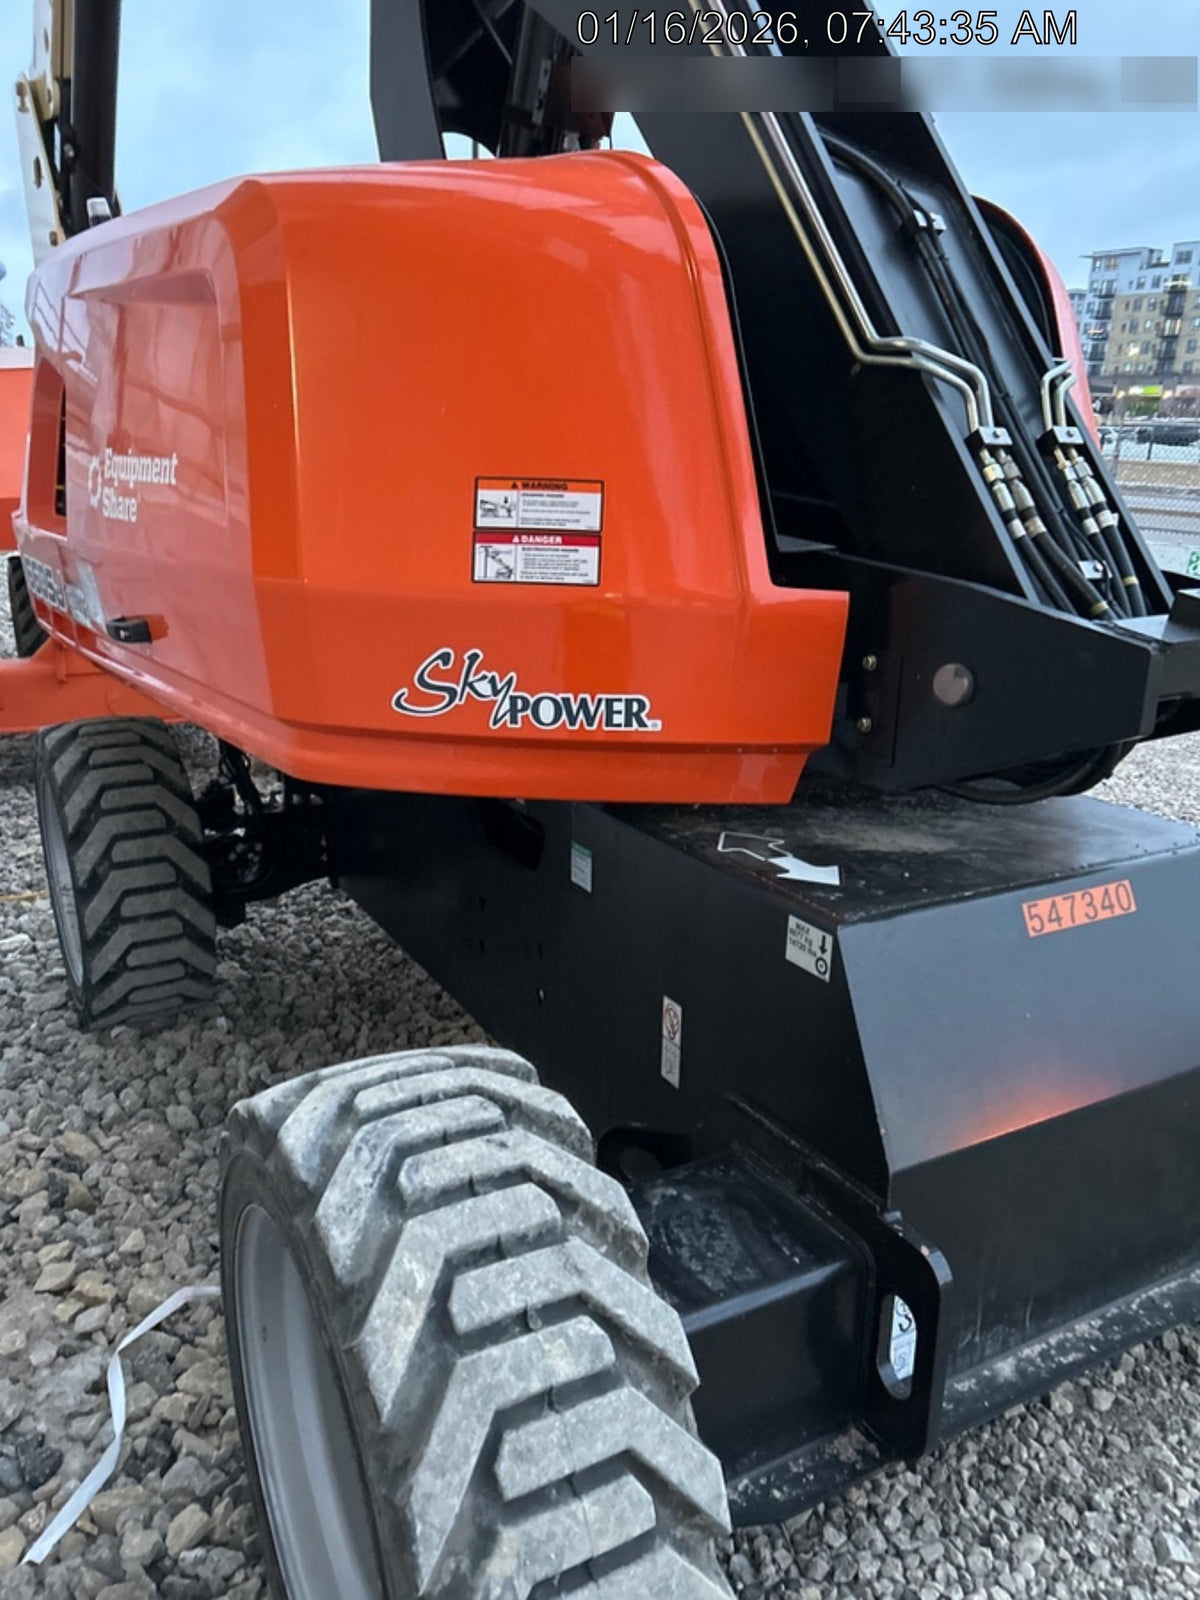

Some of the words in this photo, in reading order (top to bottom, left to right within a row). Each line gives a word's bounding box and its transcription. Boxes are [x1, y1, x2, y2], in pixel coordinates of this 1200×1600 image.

[104, 448, 178, 488] Equipment
[521, 482, 568, 490] WARNING
[102, 486, 138, 522] Share
[520, 535, 562, 544] DANGER
[1026, 882, 1132, 934] 547340
